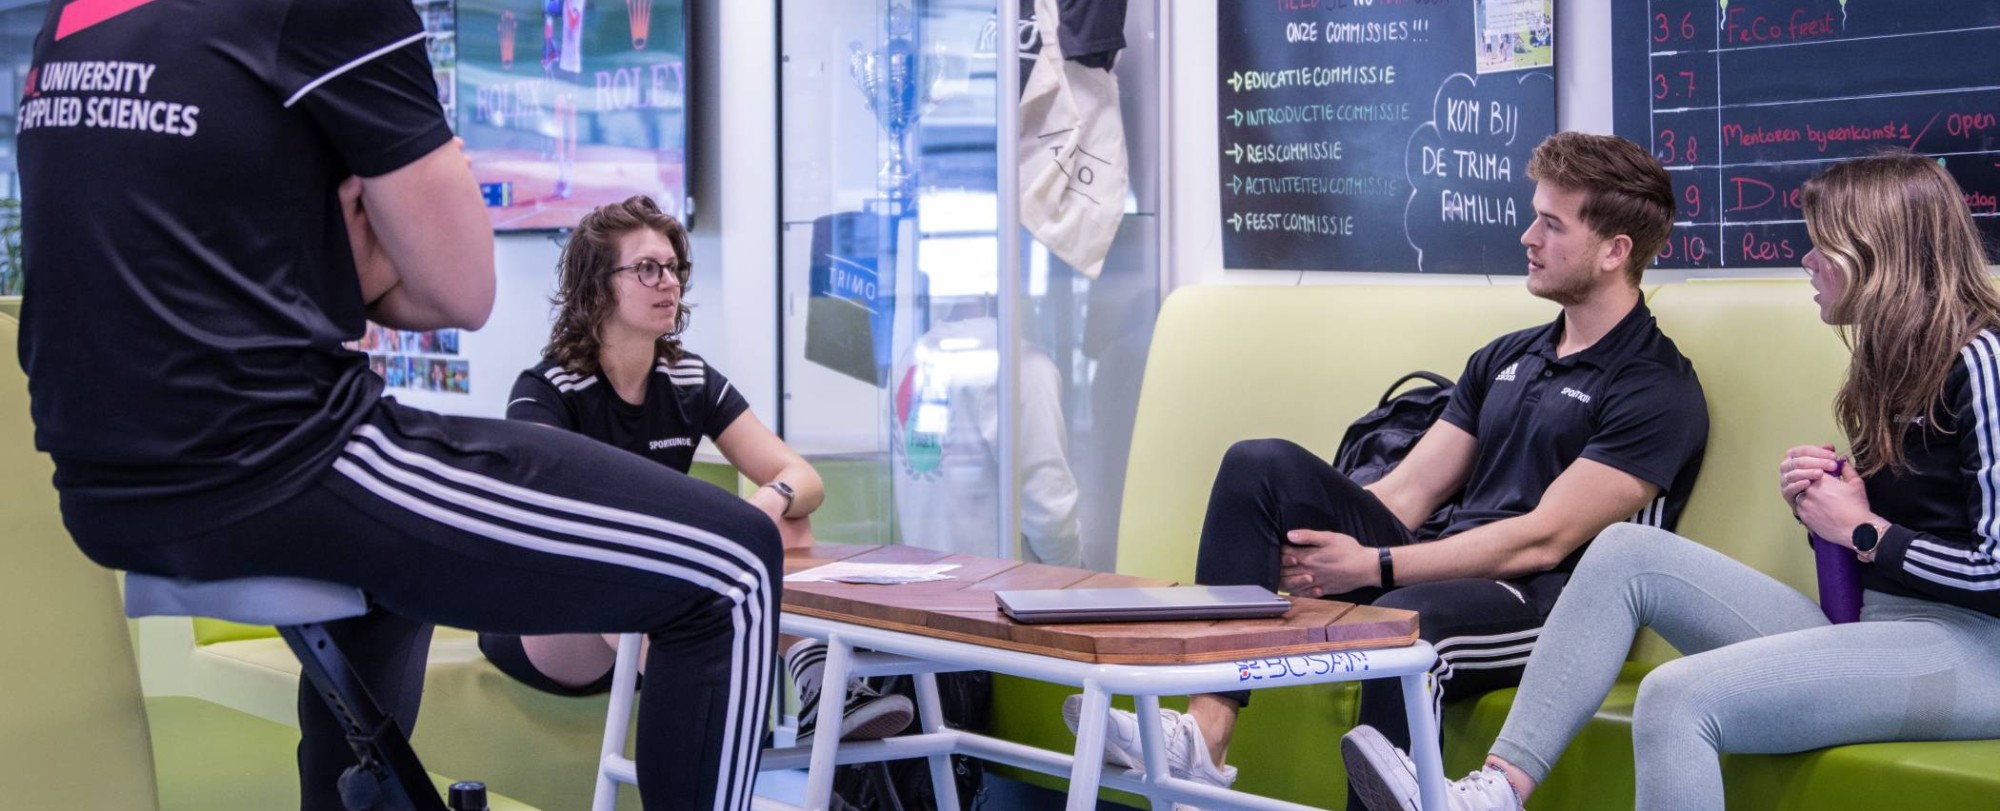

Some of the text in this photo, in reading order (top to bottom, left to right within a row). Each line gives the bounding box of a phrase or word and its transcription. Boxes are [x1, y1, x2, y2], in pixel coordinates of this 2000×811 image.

[1286, 22, 1317, 43] ONZE
[41, 61, 156, 94] UNIVERSITY
[1653, 72, 1696, 99] 3.7
[24, 97, 82, 130] APPLIED
[85, 97, 200, 137] SCIENCES
[1447, 97, 1517, 146] KOM BIJ
[1660, 129, 1698, 163] 3.8
[1946, 113, 1996, 140] Open
[1422, 146, 1511, 182] DE TRIMA
[1442, 189, 1516, 227] FAMILIA
[1742, 231, 1794, 261] Reis
[829, 267, 876, 300] TRIMO
